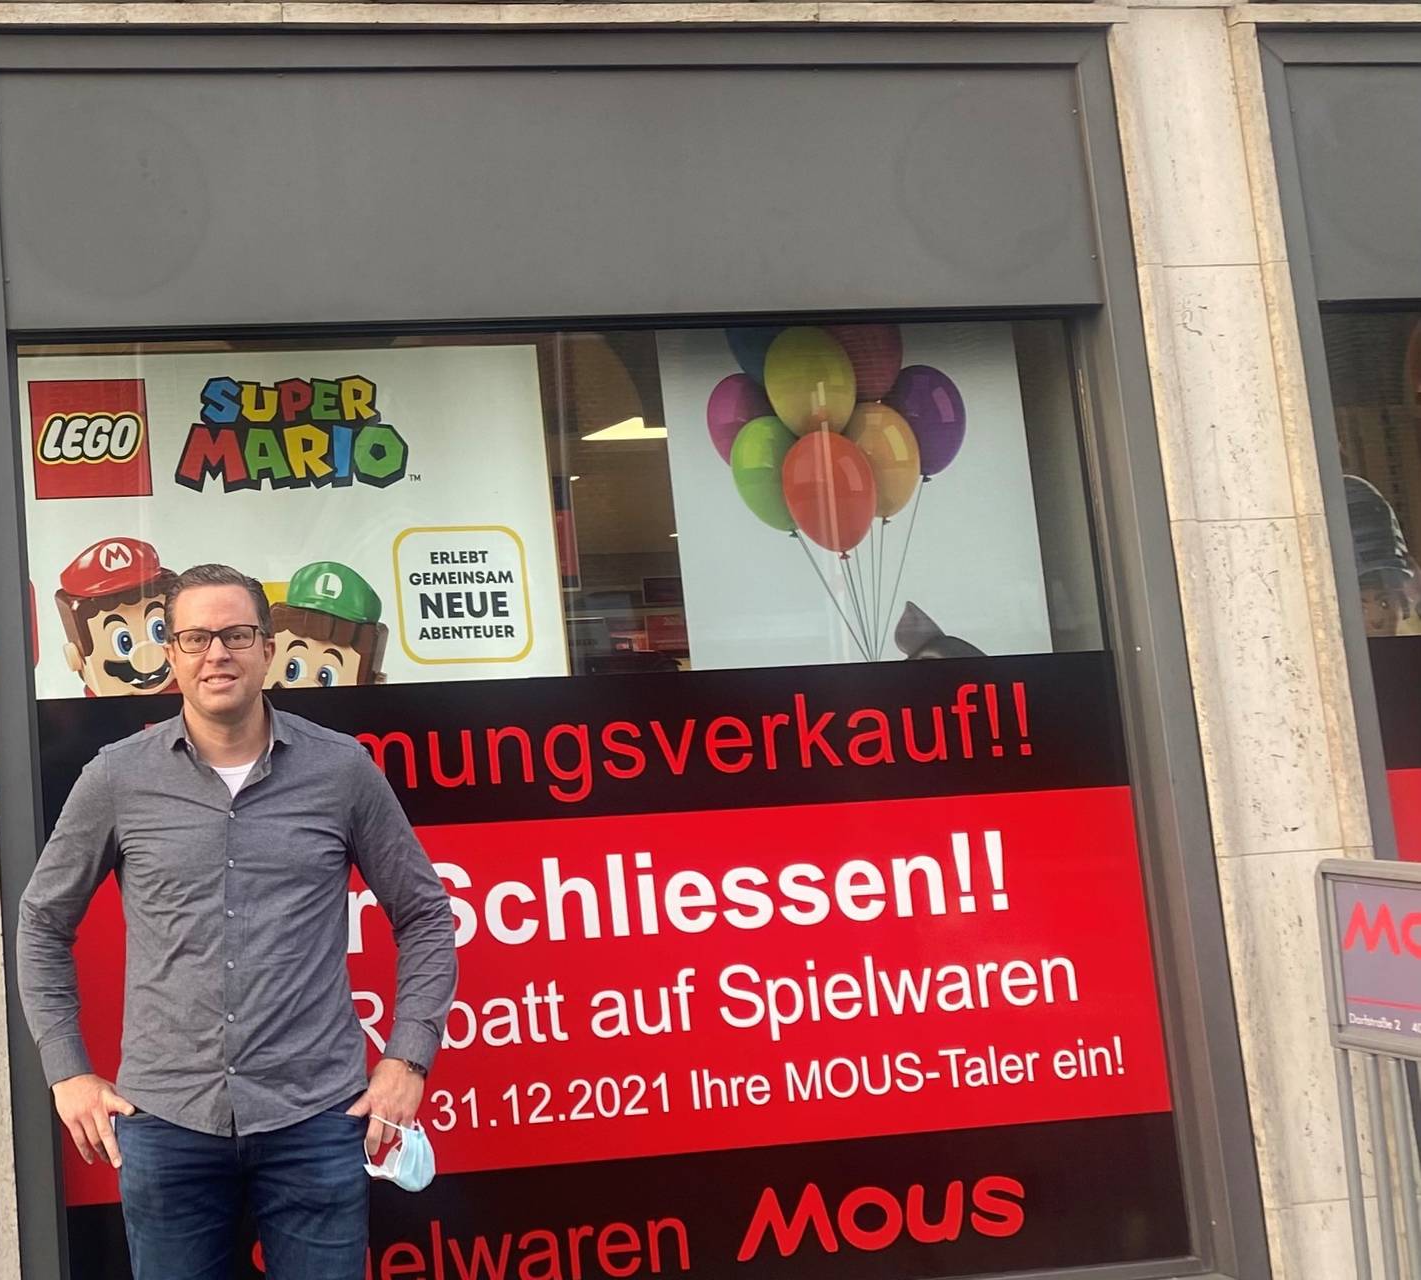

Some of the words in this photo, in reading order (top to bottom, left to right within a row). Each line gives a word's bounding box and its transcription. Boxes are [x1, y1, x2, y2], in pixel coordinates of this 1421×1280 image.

[200, 375, 379, 424] SUPER
[38, 414, 141, 462] LEGO
[175, 423, 409, 491] MARIO
[408, 571, 514, 587] GEMEINSAM
[429, 550, 489, 565] ERLEBT
[420, 592, 510, 619] NEUE
[419, 624, 515, 641] ABENTEUER
[359, 681, 1034, 802] mungsverkauf!!
[352, 979, 570, 1055] Rbatt
[589, 967, 697, 1040] auf
[717, 953, 1080, 1042] Spielwaren
[1393, 1018, 1402, 1031] 2
[429, 1071, 672, 1134] 31.12.2021
[690, 1068, 772, 1111] Ihre
[785, 1044, 1040, 1102] MOUS-Taler
[1052, 1035, 1126, 1081] ein!
[252, 1216, 691, 1280] elwaren
